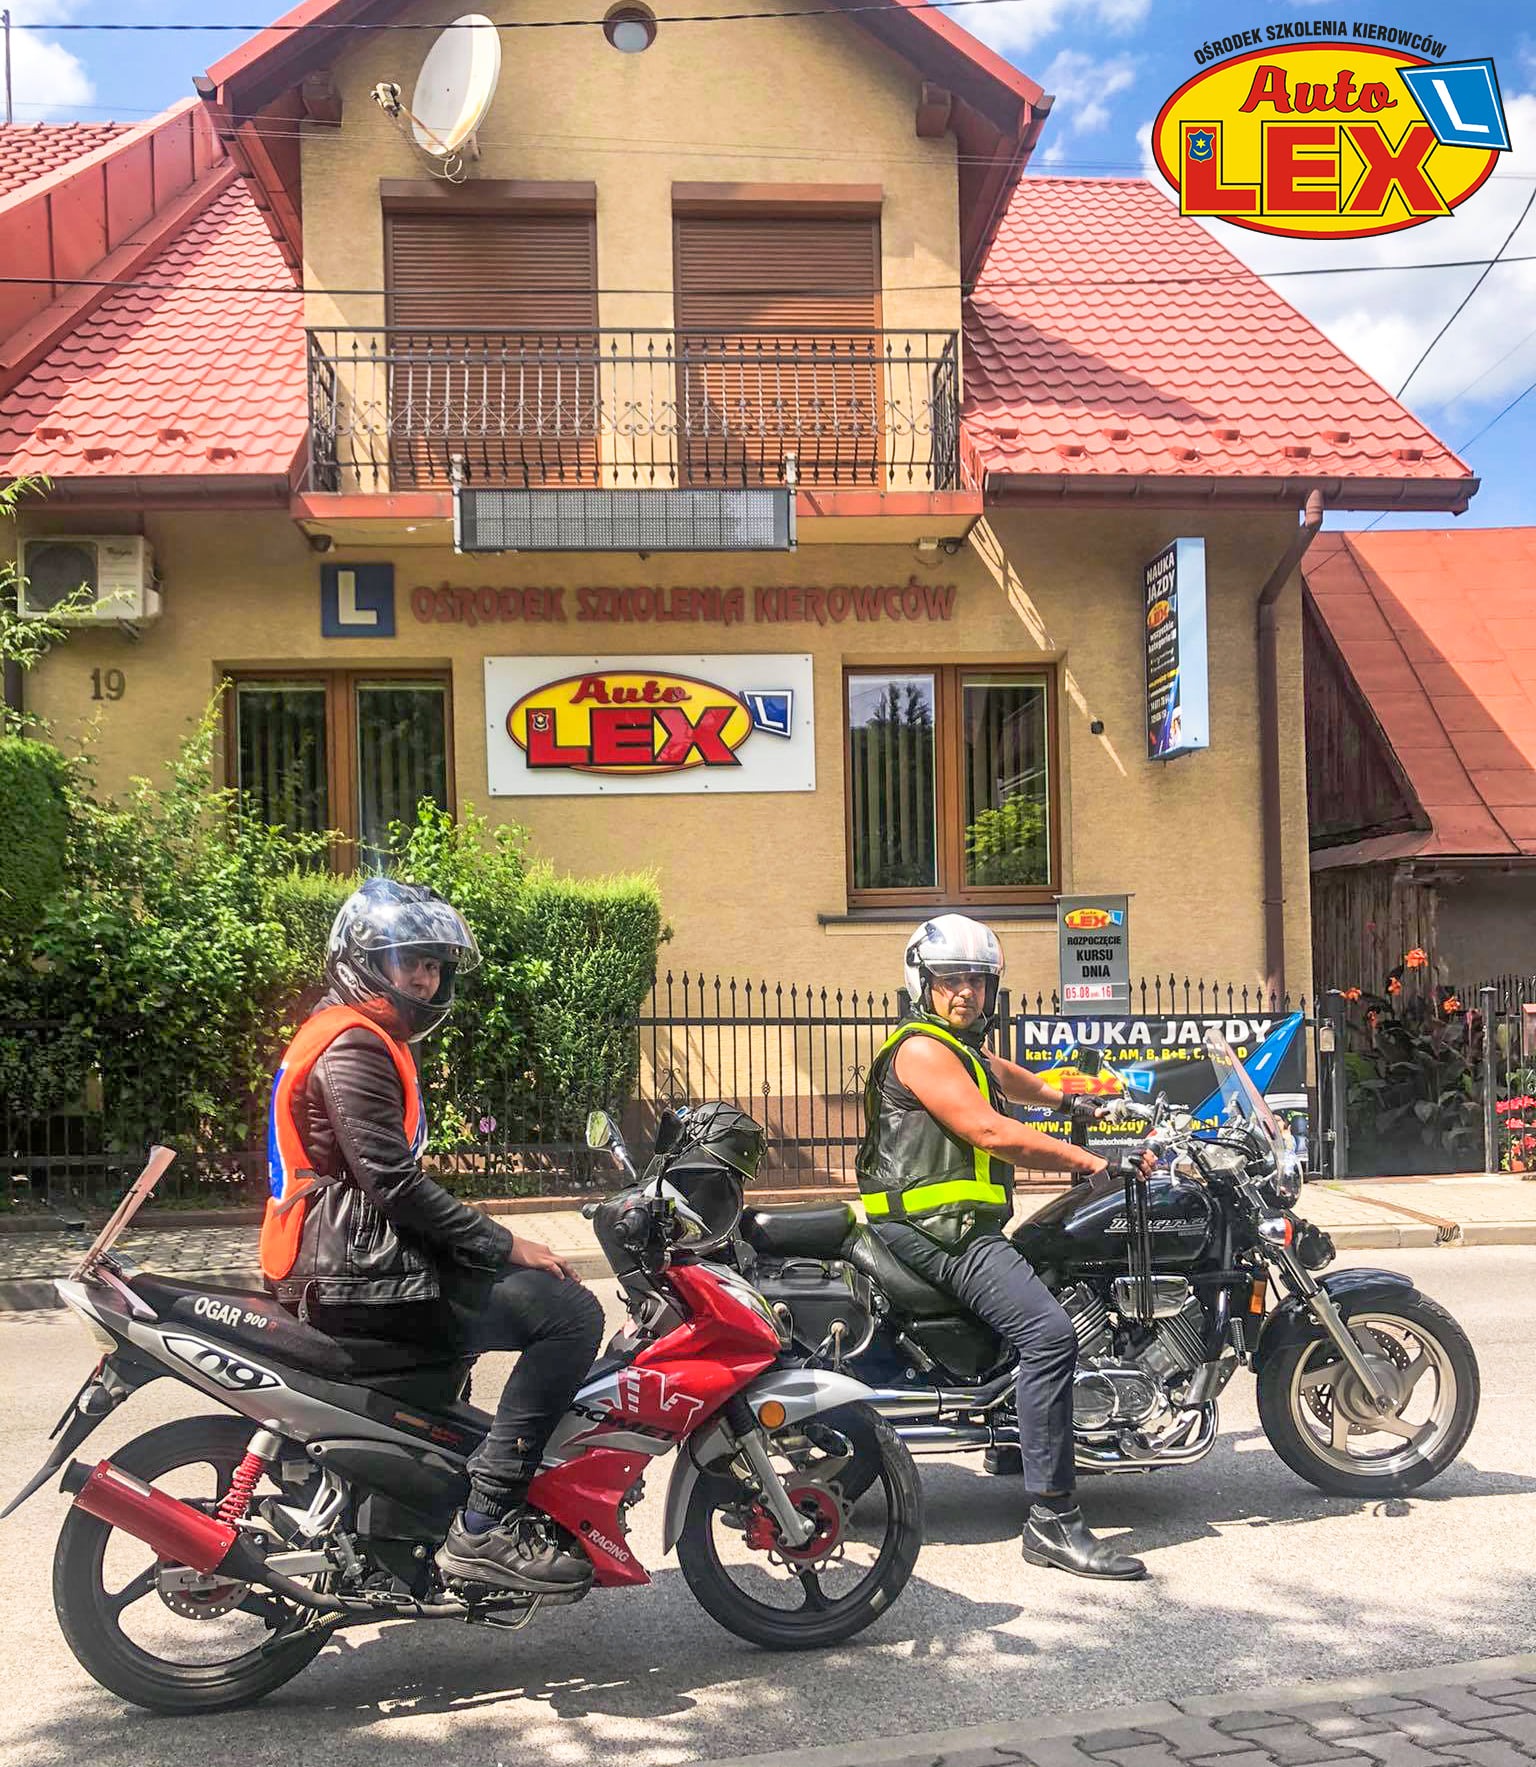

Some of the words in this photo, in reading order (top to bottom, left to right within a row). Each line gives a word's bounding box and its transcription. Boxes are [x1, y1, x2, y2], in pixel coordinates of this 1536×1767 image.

[1146, 551, 1175, 585] NAUKA
[337, 571, 378, 625] L
[410, 581, 568, 628] OŚRODEK
[575, 586, 745, 626] SZKOLENIA
[754, 575, 957, 627] KIEROWCÓW
[1146, 569, 1175, 605] JAZDY
[90, 667, 126, 701] 19
[569, 676, 692, 704] Auto
[755, 696, 784, 729] L
[525, 706, 743, 769] LEX
[1068, 915, 1108, 928] LEX
[1067, 935, 1122, 947] ROZPOCZĘCIE
[1076, 949, 1113, 961] KURSU
[1082, 965, 1110, 978] DNIA
[1065, 986, 1090, 999] 05.08
[1101, 985, 1112, 998] 16
[1024, 1020, 1152, 1045] NAUKA
[1160, 1019, 1272, 1045] JAZDY
[1025, 1048, 1052, 1061] kat:
[1237, 1046, 1248, 1059] D
[1061, 1078, 1121, 1095] EX
[194, 1297, 242, 1328] OGAR
[243, 1312, 267, 1328] 900
[588, 1529, 630, 1562] RACING
